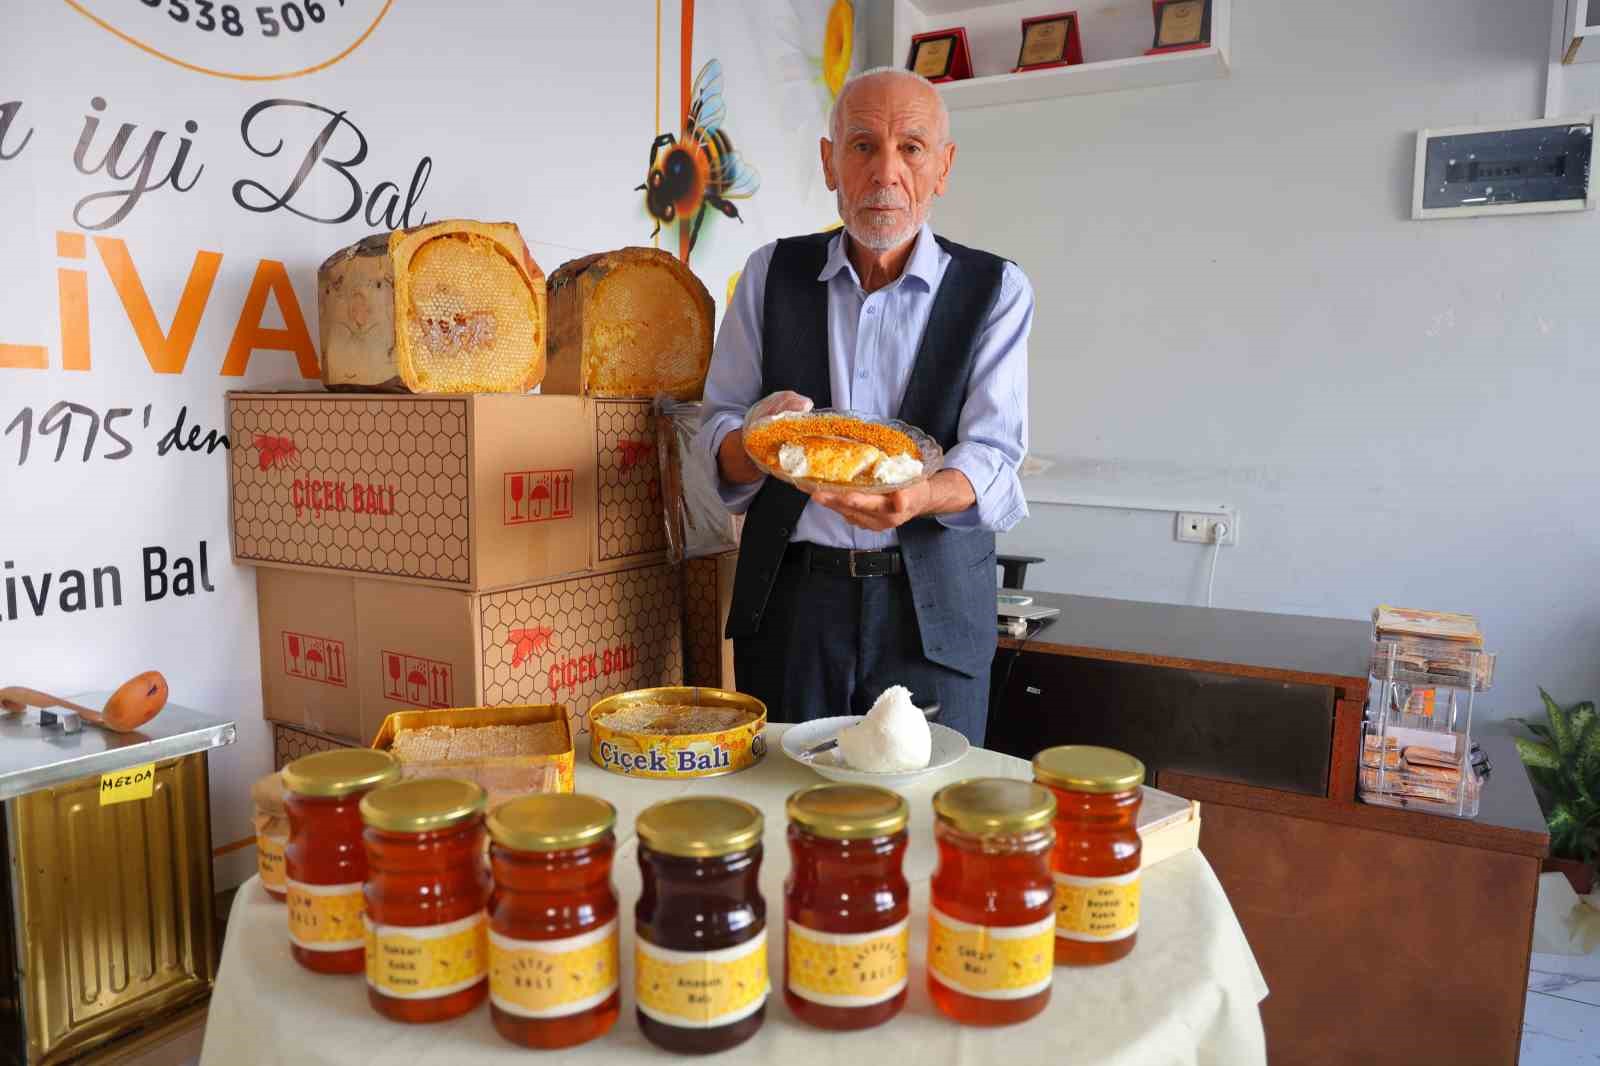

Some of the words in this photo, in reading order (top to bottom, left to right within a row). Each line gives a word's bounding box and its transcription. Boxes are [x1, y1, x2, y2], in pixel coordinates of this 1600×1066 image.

[139, 0, 244, 37] 538
[256, 0, 327, 38] 506
[72, 96, 205, 232] iyi
[231, 98, 433, 231] Bal
[0, 560, 122, 621] ivan
[142, 540, 215, 602] Bal
[600, 740, 667, 773] Çiçek
